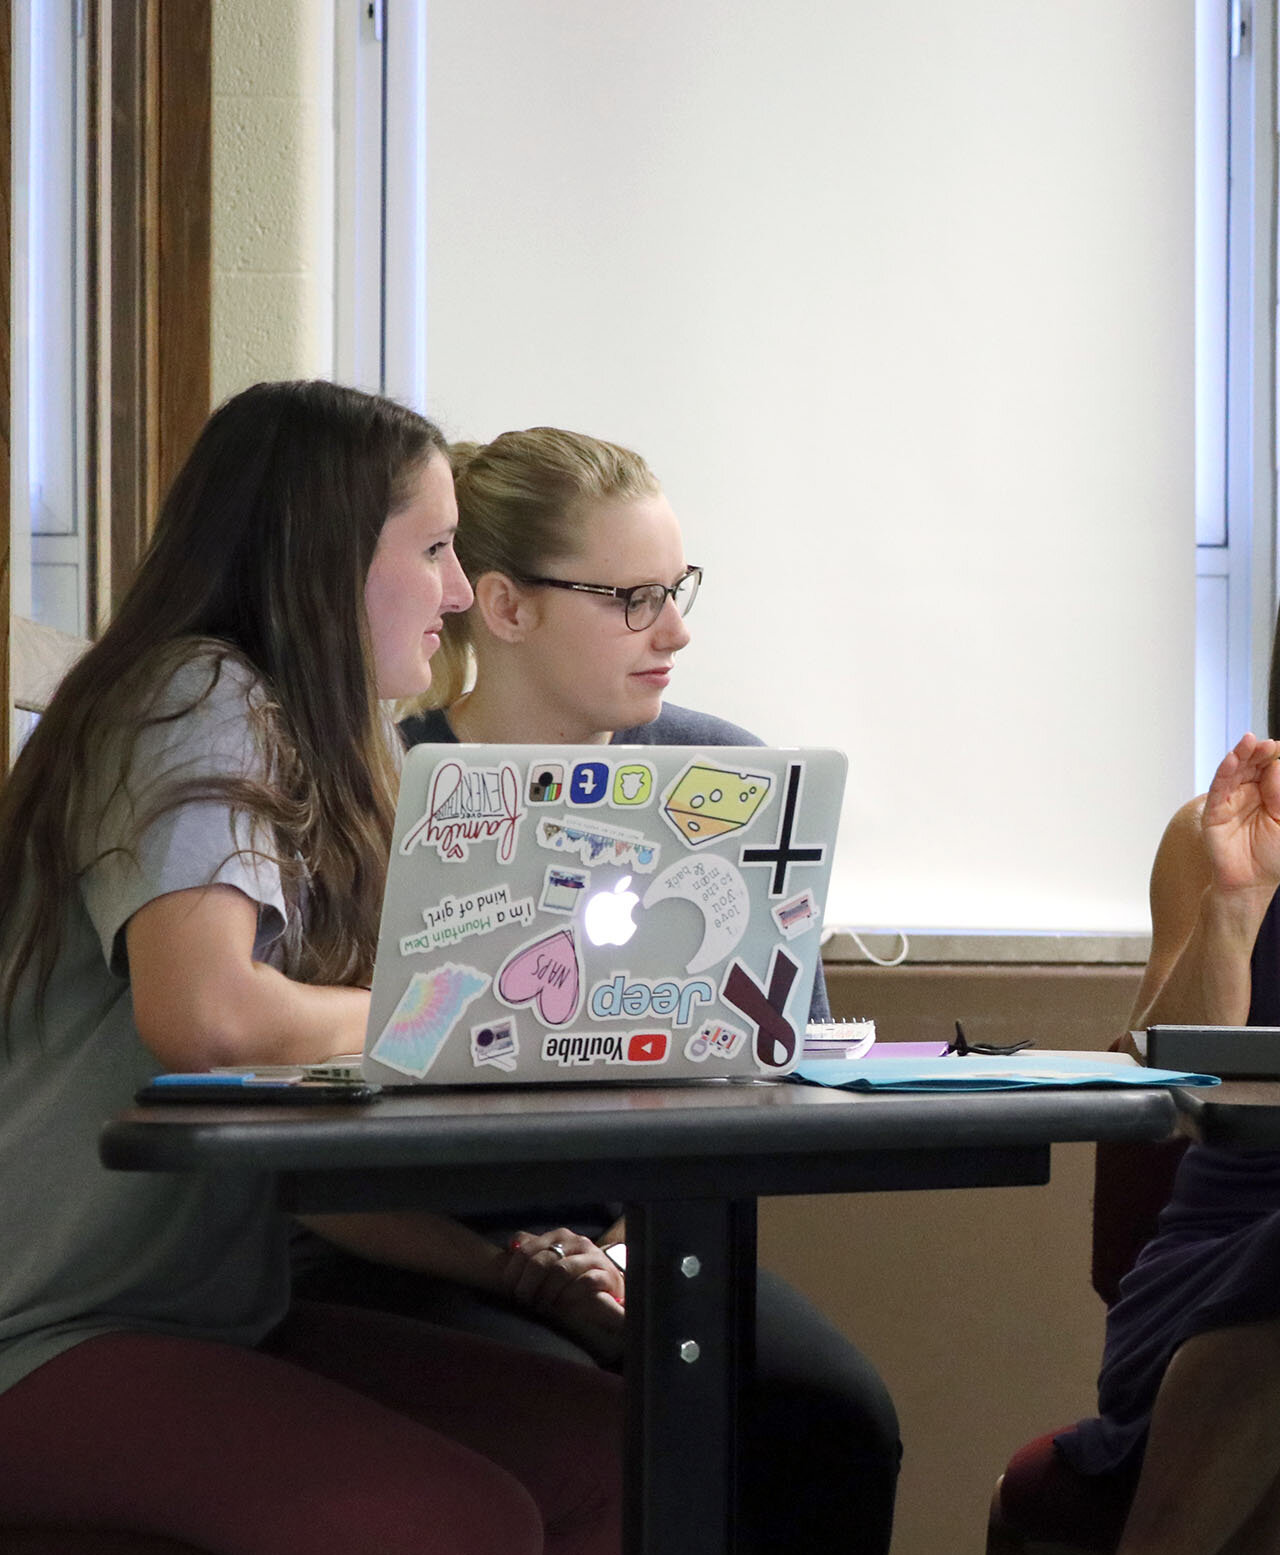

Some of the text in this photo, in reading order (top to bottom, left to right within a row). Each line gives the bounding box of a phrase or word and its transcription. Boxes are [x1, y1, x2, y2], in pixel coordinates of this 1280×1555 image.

[404, 763, 522, 861] family
[461, 811, 483, 820] over
[664, 862, 706, 889] & back
[691, 867, 720, 891] moon
[701, 872, 733, 902] to the
[428, 889, 508, 927] kind of girl
[711, 889, 737, 914] you
[432, 916, 491, 943] Mountain
[496, 911, 505, 923] a
[714, 904, 741, 929] love
[404, 934, 430, 952] Dew
[530, 953, 571, 990] NAPS
[591, 975, 712, 1025] Jeep
[546, 1035, 623, 1061] YouTube
